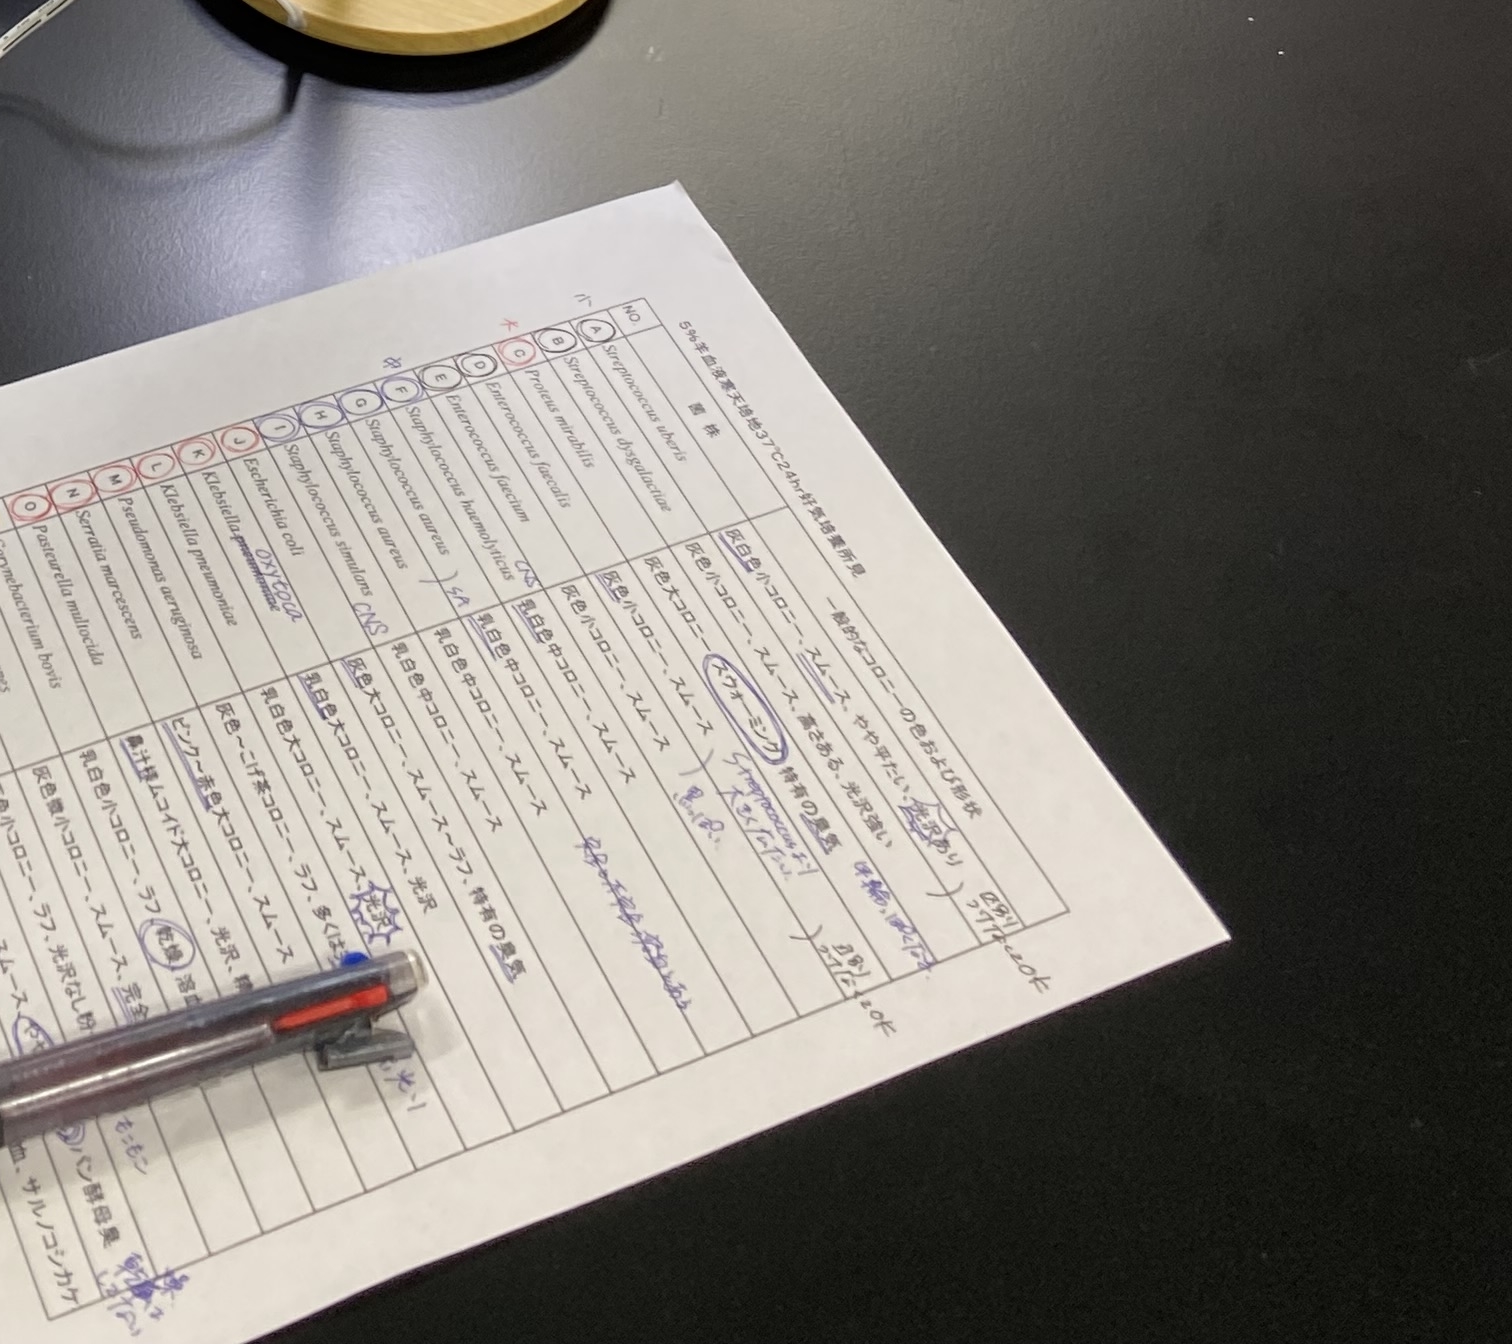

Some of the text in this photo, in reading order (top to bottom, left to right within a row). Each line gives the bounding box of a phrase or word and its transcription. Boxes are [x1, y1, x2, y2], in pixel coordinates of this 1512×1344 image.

[620, 304, 644, 326] NO.
[444, 392, 533, 524] Enterococcus faecium
[484, 380, 573, 510] Enterococcus faecalis
[524, 368, 596, 469] Proteus mirabilis
[560, 355, 675, 514] Streptococcus dysgalactiae
[599, 343, 689, 463] Streptococcus uberis
[158, 482, 240, 629] Klebsiella pneumoniae
[201, 470, 243, 533] Klebsiella
[242, 456, 304, 557] Escherichia coli
[279, 442, 375, 597] Staphylococcus simulans
[321, 429, 409, 571] Staphylococcus aureus
[361, 417, 451, 557] Staphylococcus aureus
[402, 404, 518, 583] Staphylococcus haemolyticus
[31, 523, 106, 667] Pasteurella multocida
[74, 508, 144, 640] Serratia marcescens
[116, 495, 204, 661] Pseudomonas aeruginosa
[249, 546, 303, 624] oxytoca
[351, 598, 388, 639] CNS
[36, 650, 65, 691] bovis
[432, 626, 551, 817] 乳白色中コロニー、スムース
[474, 611, 595, 801] 乳白色中コロニー、スムース
[517, 597, 639, 784] 乳白色中コロニー、スムース
[559, 583, 673, 752] 灰色小コロニー、スムース
[601, 569, 716, 736] 灰色小コロニー、スムース
[820, 595, 983, 820] 一般的なコロニーの色および形状
[389, 641, 505, 833] 乳白色中コロニー、スムース
